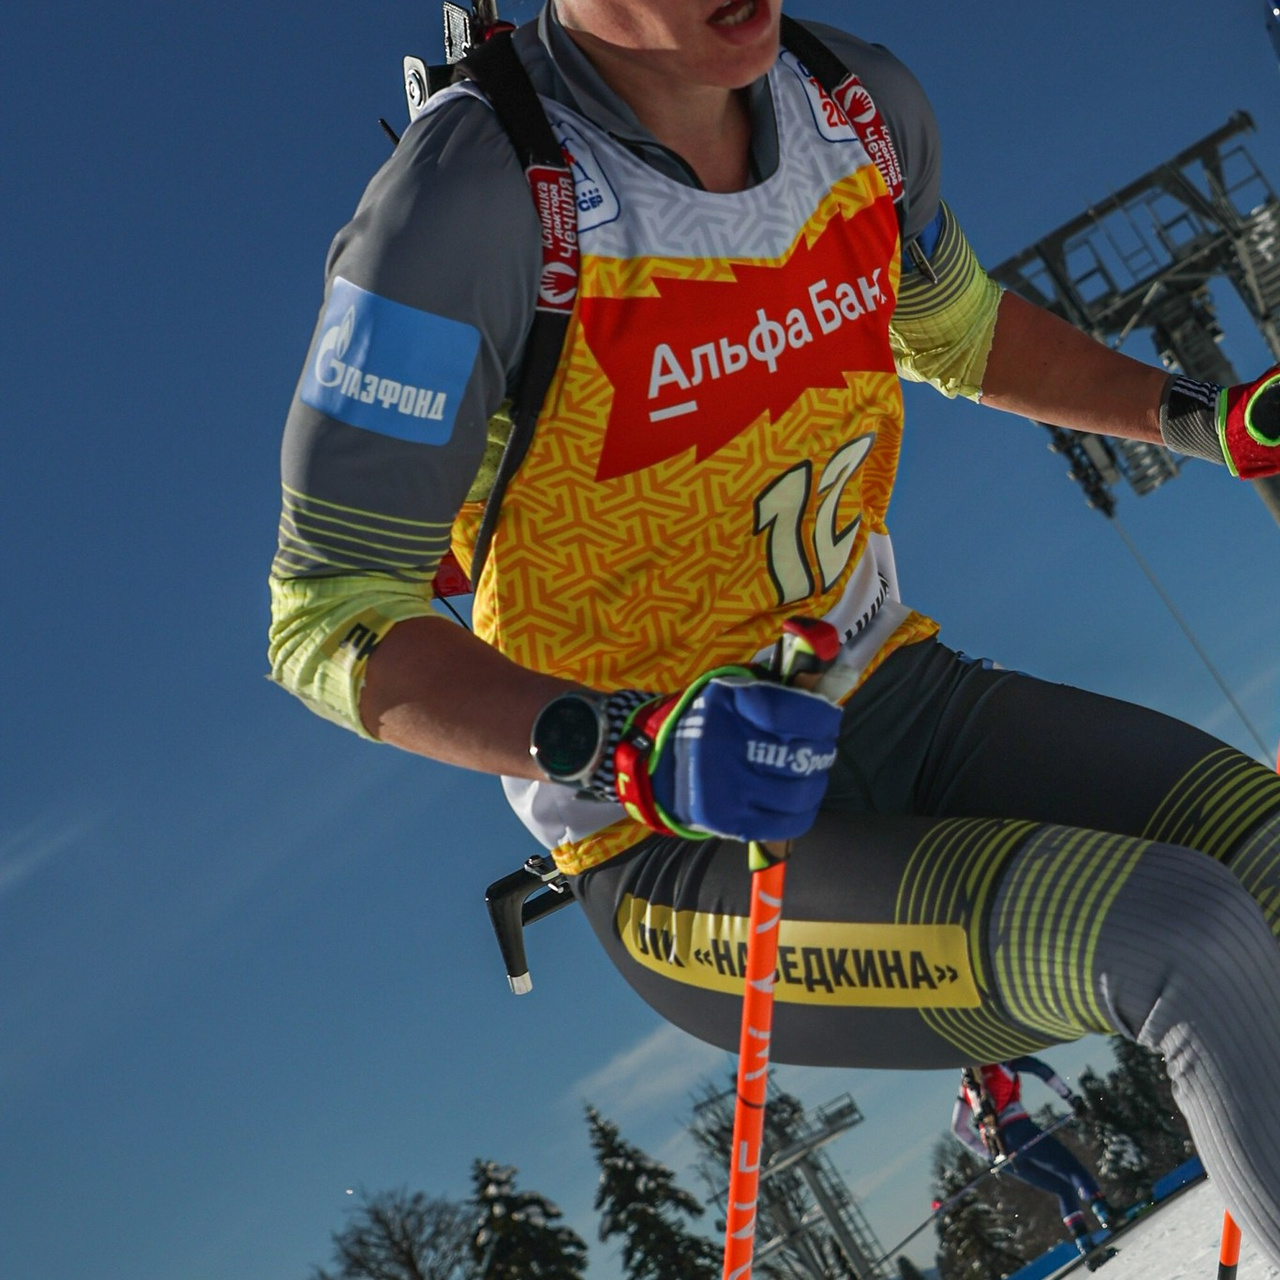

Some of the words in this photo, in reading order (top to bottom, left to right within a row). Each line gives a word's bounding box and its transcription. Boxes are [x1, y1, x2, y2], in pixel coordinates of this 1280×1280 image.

[537, 182, 553, 249] Клиника
[549, 184, 560, 242] доктора
[559, 176, 577, 258] Чечиля
[648, 308, 813, 399] Альфа
[752, 431, 877, 606] 12
